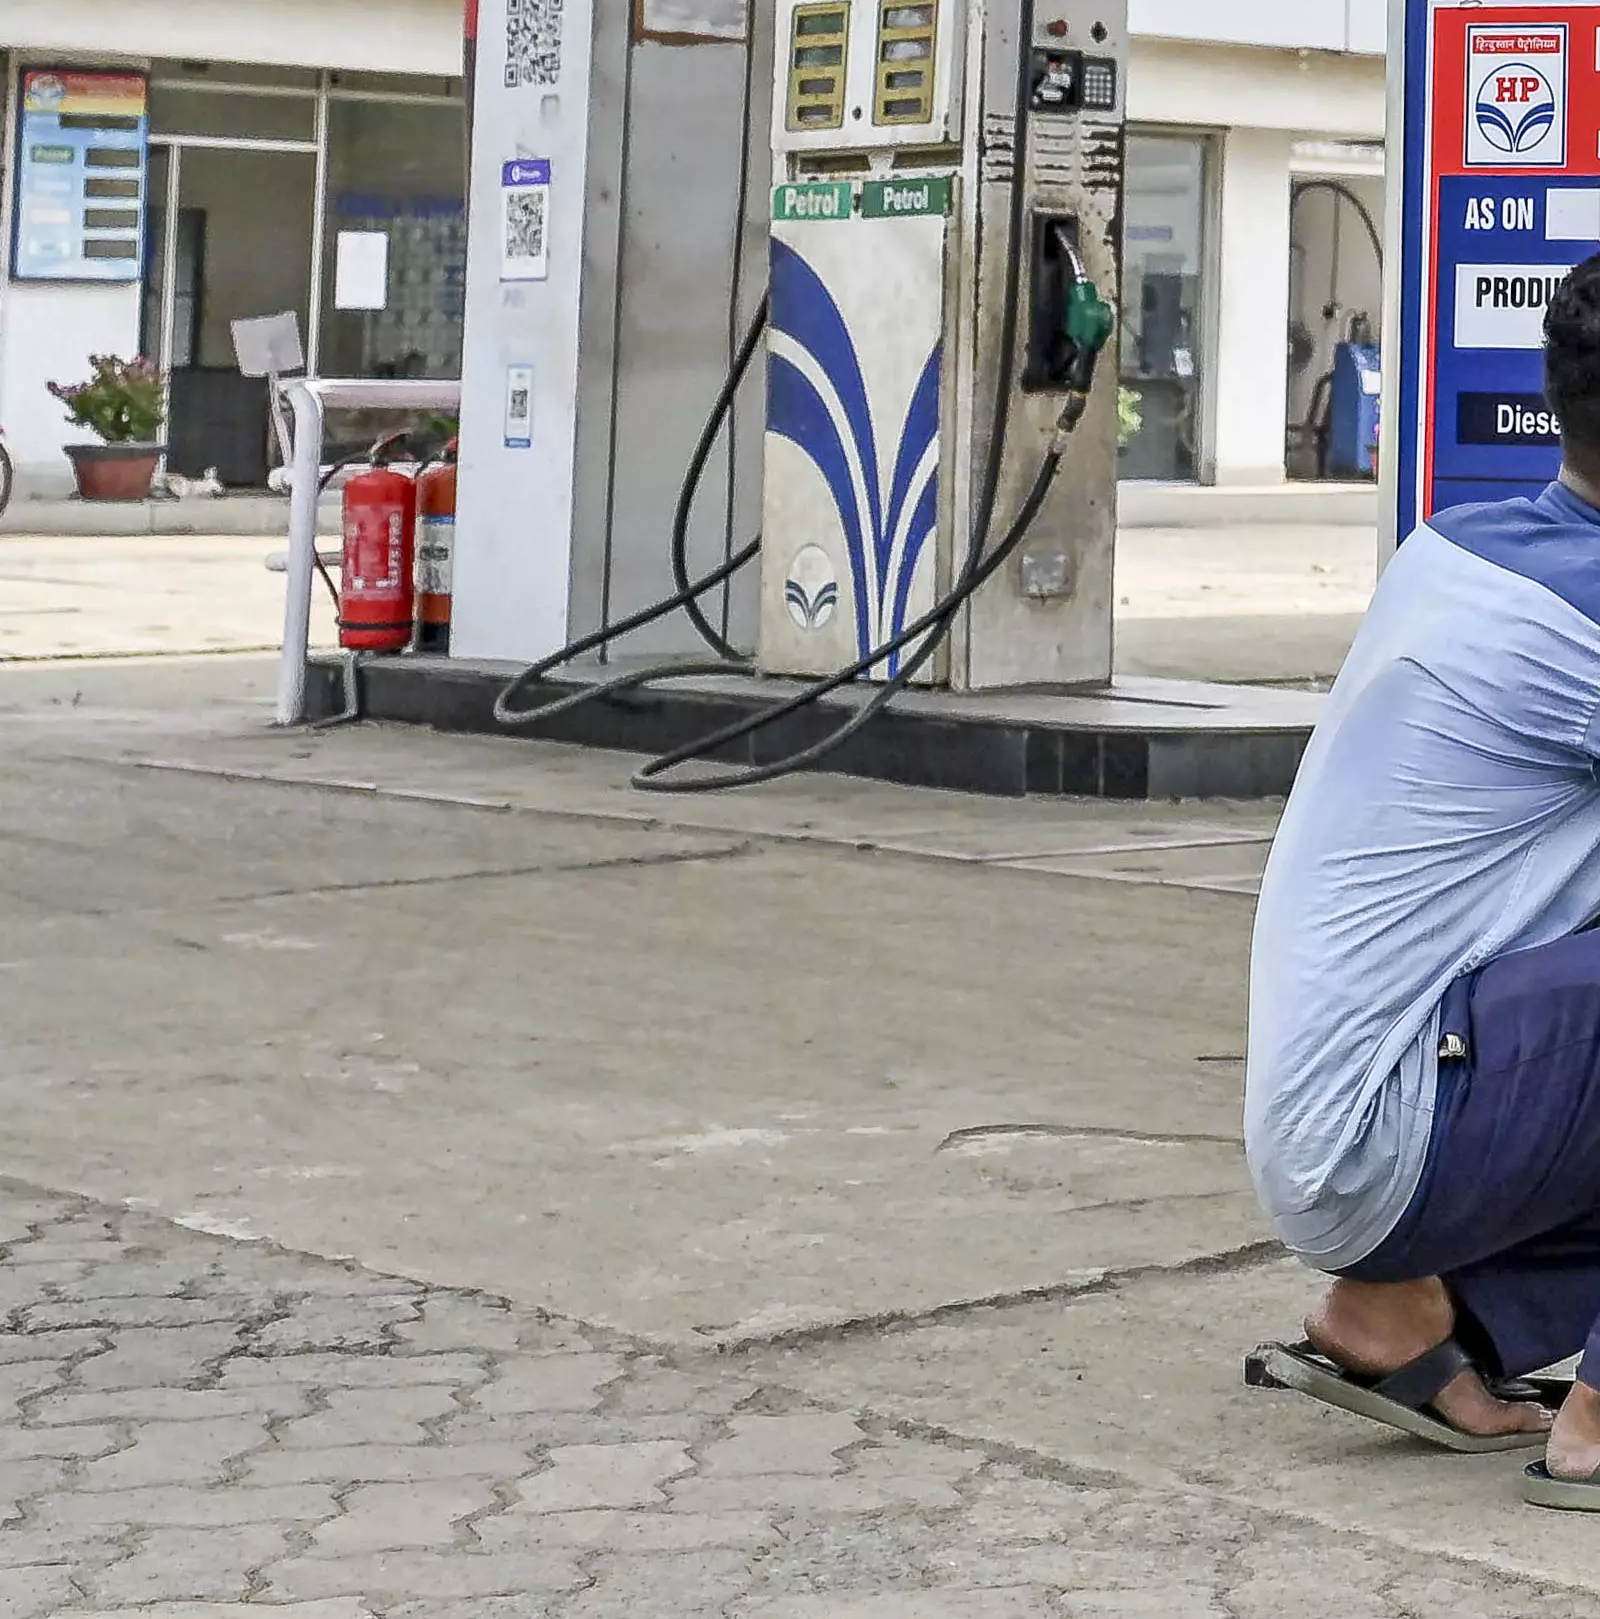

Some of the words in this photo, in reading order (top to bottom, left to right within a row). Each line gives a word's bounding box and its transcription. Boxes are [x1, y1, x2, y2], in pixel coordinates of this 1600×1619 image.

[1495, 77, 1540, 103] HP
[784, 187, 840, 216] Petrol
[883, 183, 930, 212] Petrol
[1464, 197, 1496, 231] AS
[1502, 197, 1534, 231] ON
[1475, 276, 1568, 309] PRODU
[1496, 403, 1561, 435] Diese
